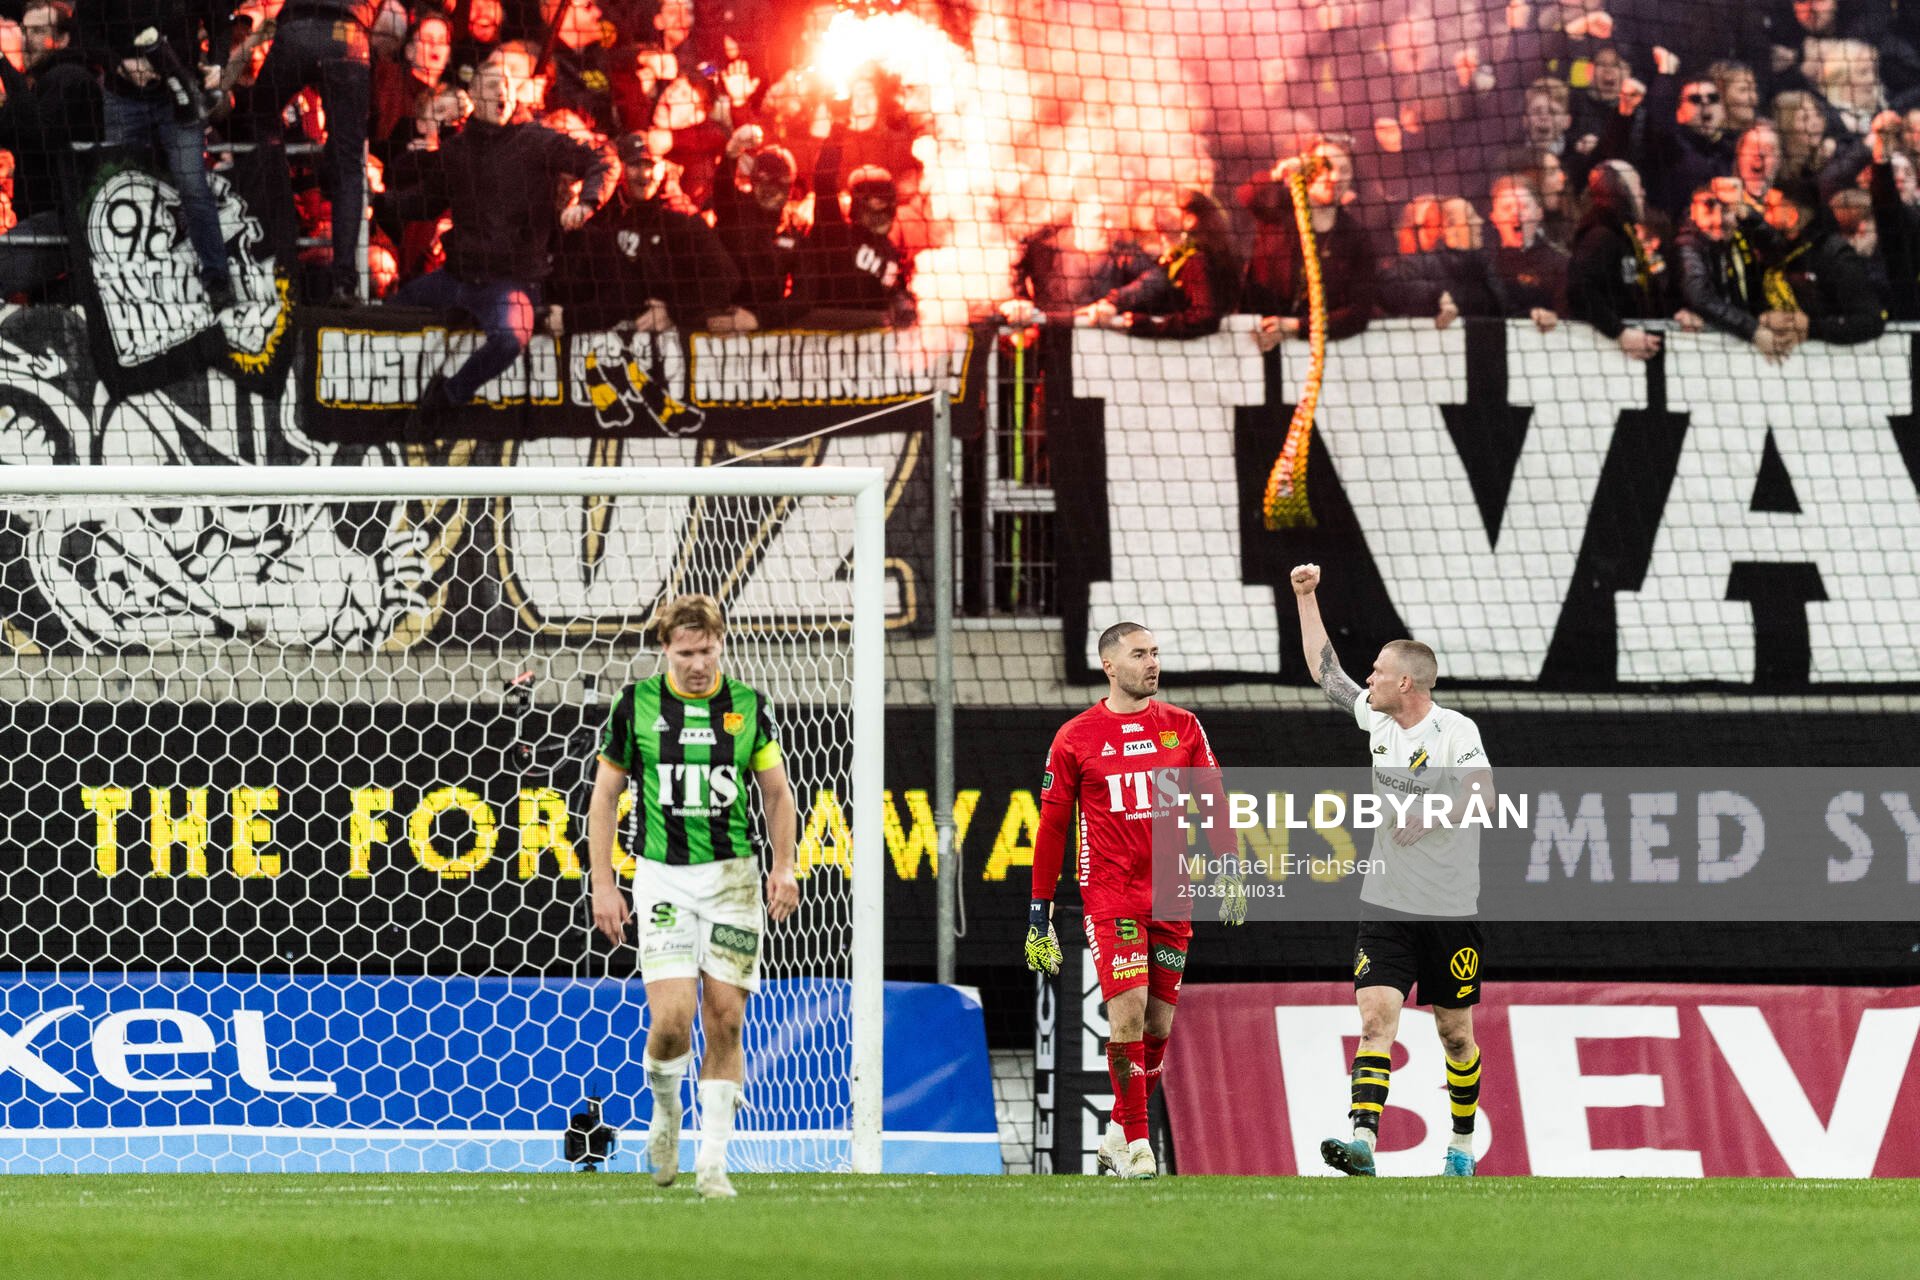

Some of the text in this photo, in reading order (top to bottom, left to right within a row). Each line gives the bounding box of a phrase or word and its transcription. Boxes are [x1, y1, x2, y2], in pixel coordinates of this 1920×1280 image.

[1126, 742, 1153, 752] SKAB
[656, 764, 738, 807] ITS
[1105, 768, 1180, 813] ITS
[81, 787, 281, 879] THE
[349, 786, 638, 879] FOR
[1525, 790, 1766, 884] MED
[1035, 970, 1055, 1175] SELEC
